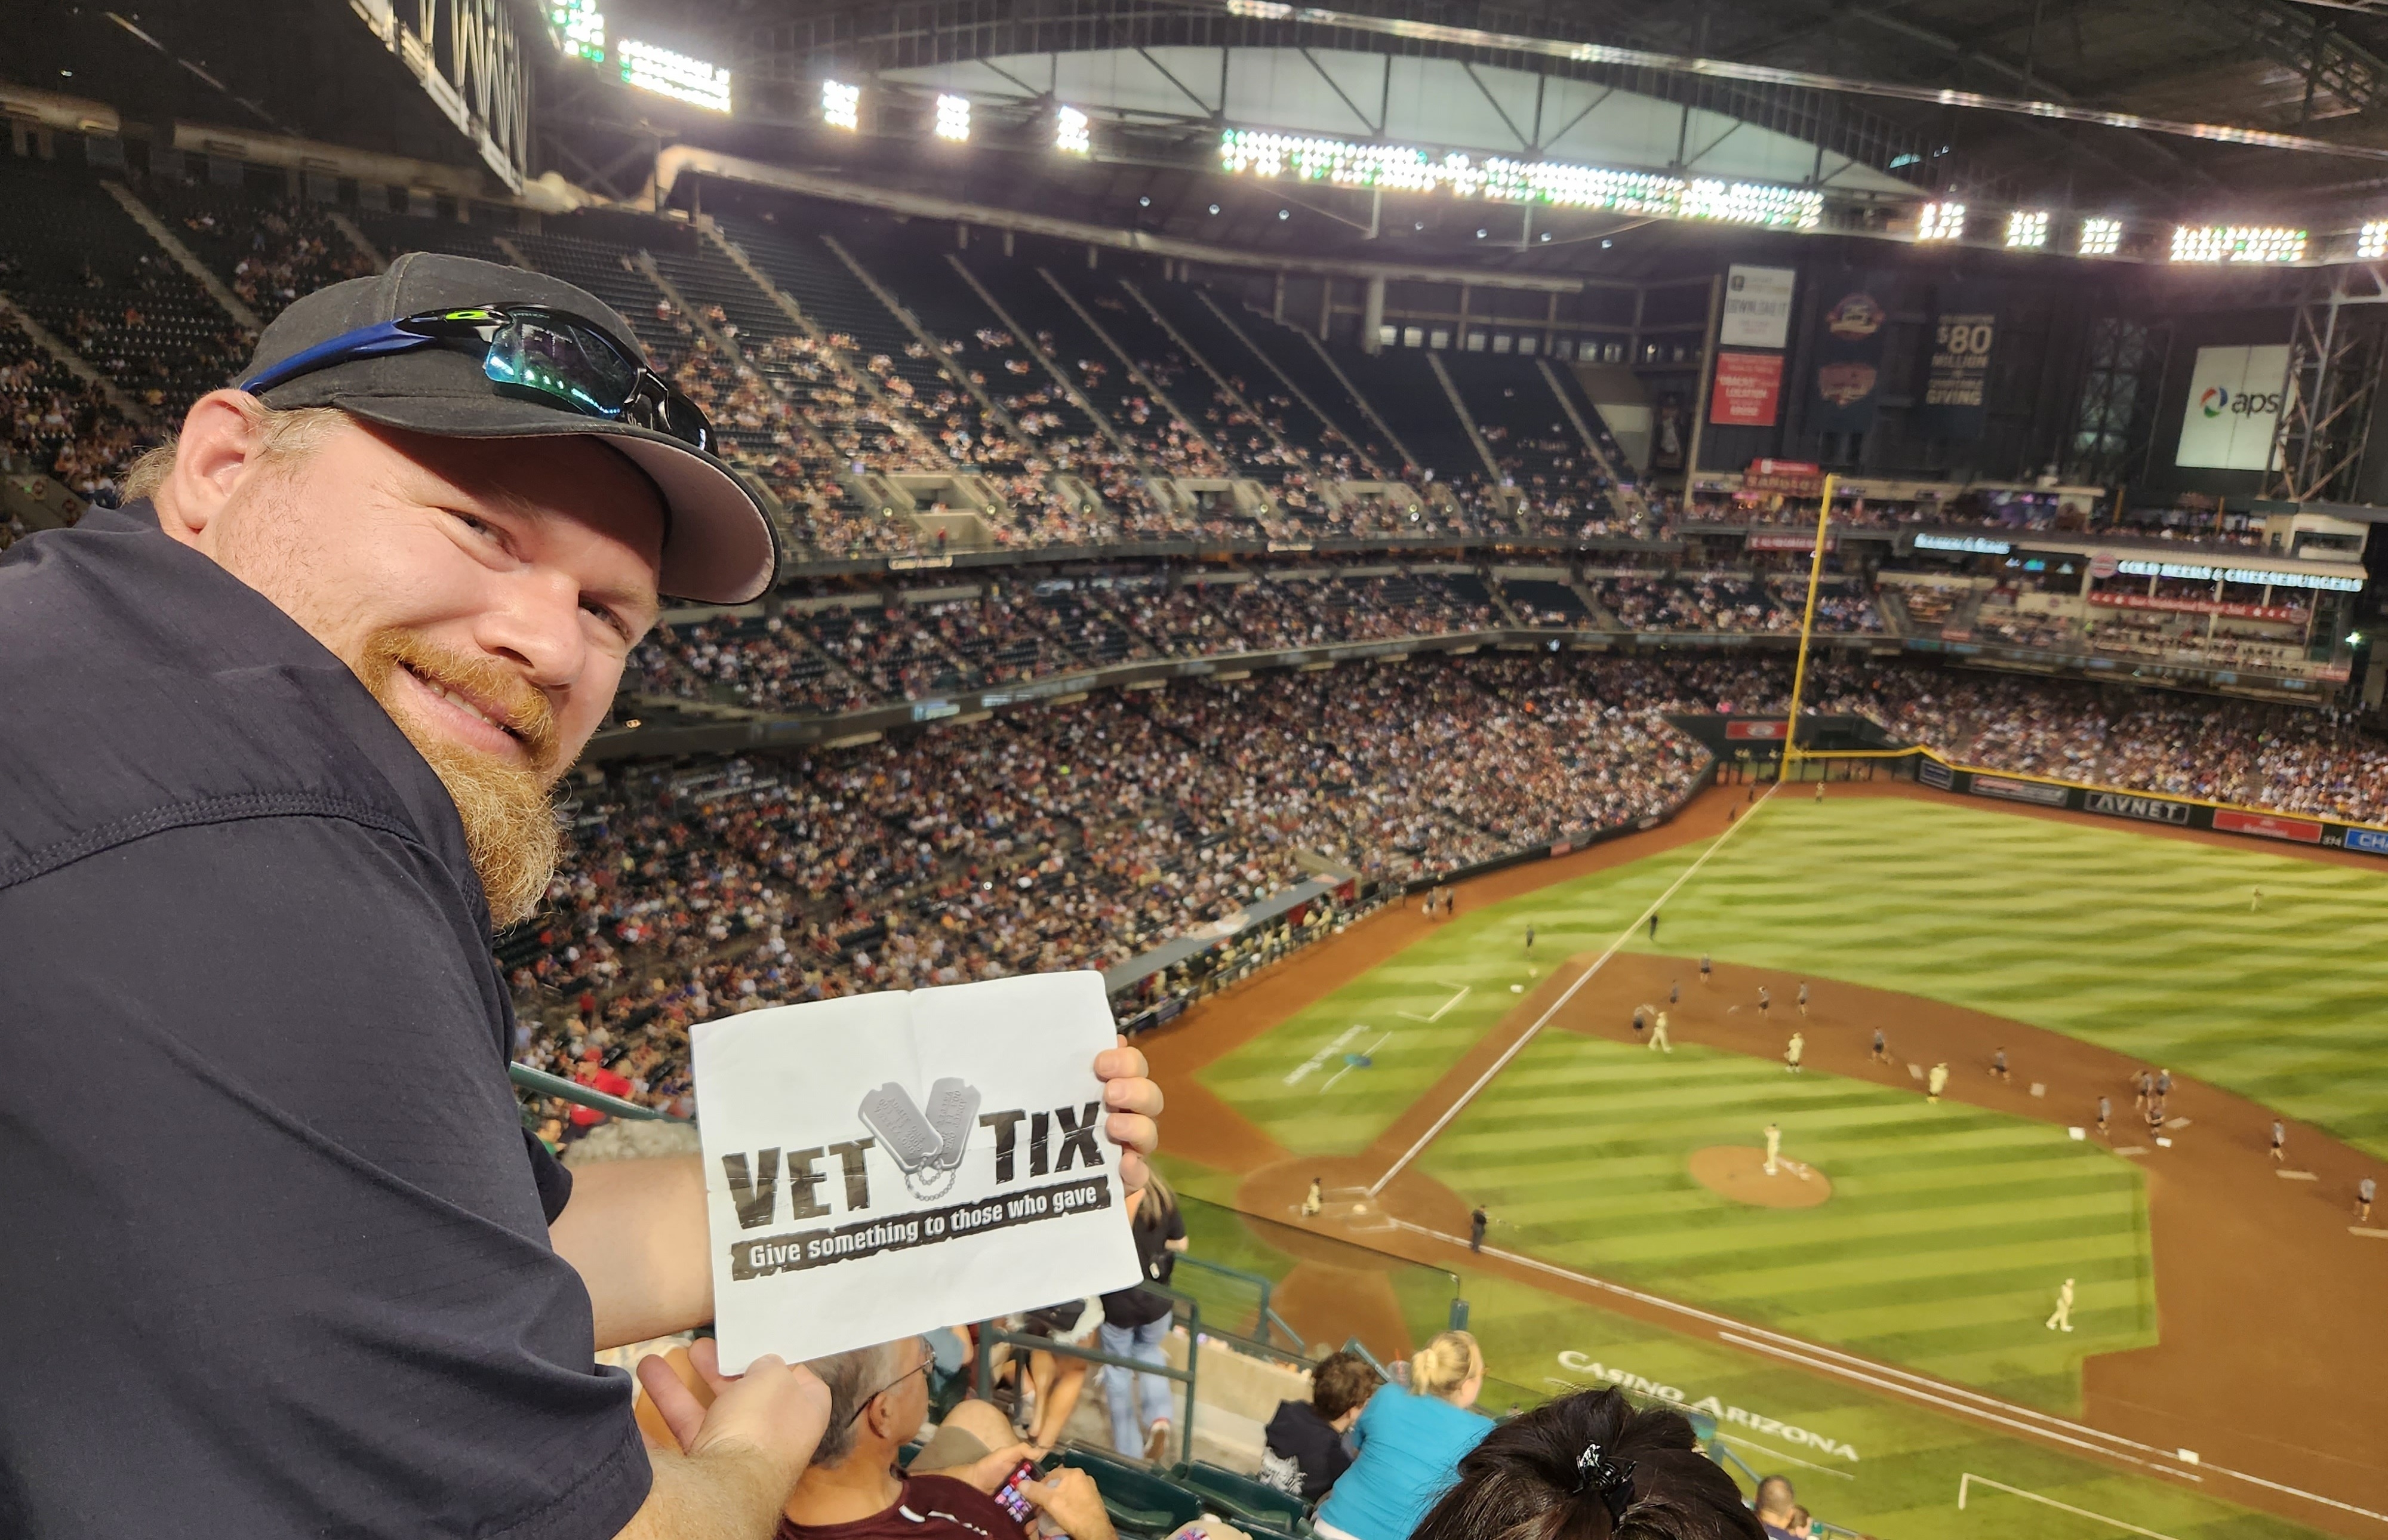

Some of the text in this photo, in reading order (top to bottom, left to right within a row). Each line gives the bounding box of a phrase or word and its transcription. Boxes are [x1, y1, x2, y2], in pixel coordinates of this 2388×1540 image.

[1936, 325, 1993, 355] $80
[2231, 392, 2280, 418] aps
[2095, 793, 2178, 820] AVNET
[721, 1102, 1107, 1231] VET TIX
[749, 1187, 1097, 1269] Give something to those who gave
